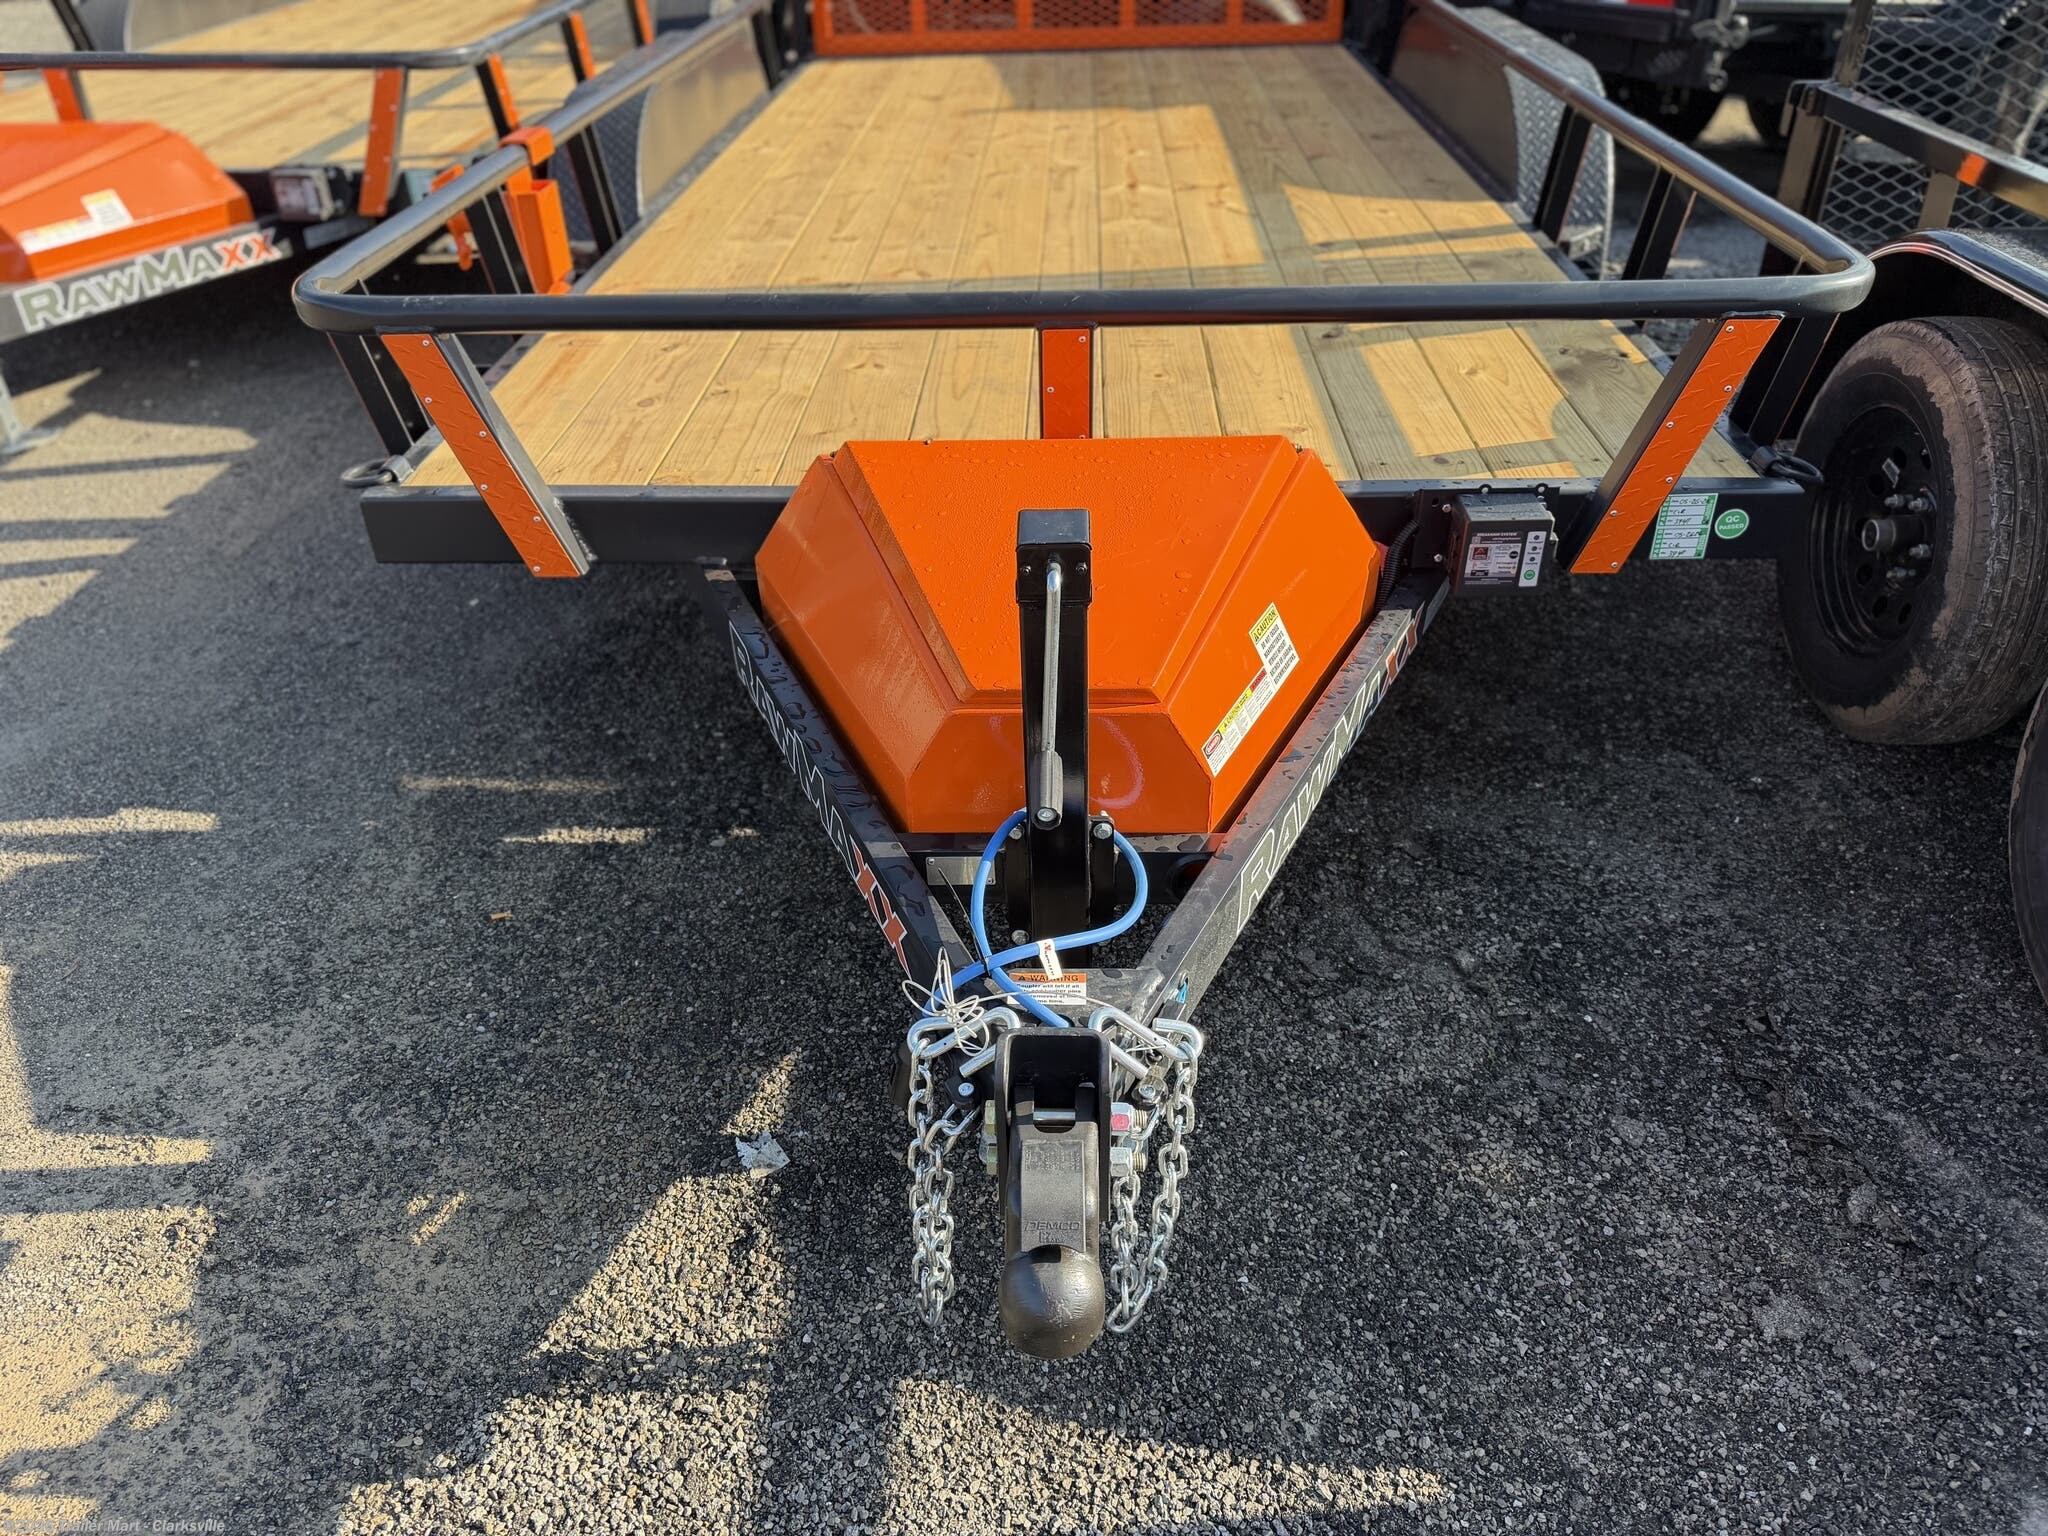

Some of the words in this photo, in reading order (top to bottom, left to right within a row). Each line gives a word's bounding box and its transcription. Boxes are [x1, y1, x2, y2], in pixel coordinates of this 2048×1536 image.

[1725, 515, 1740, 523] QC
[1257, 609, 1277, 637] CAUTION
[1024, 1221, 1080, 1231] DEMCO
